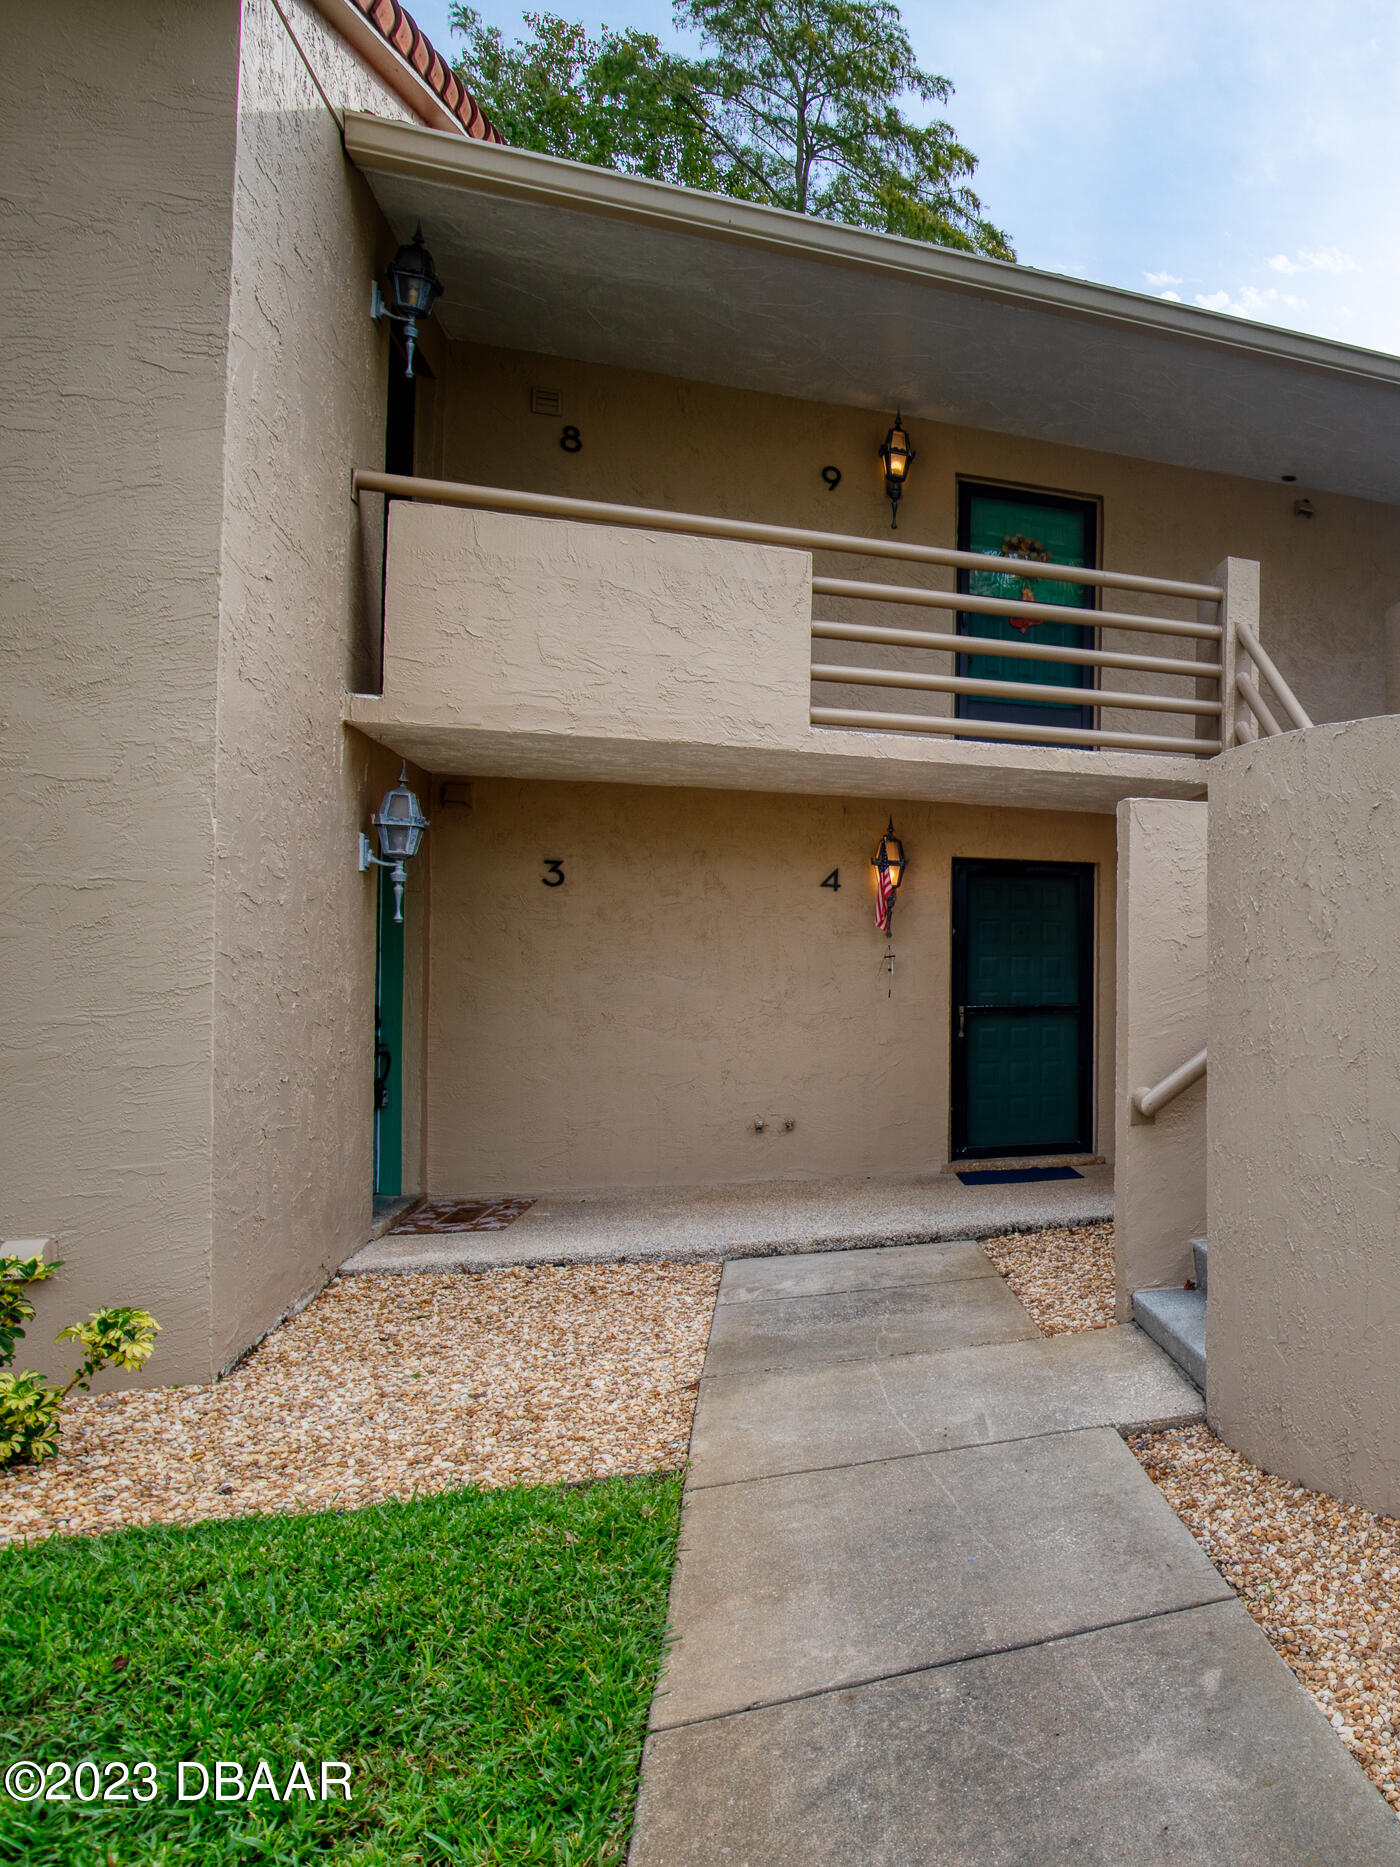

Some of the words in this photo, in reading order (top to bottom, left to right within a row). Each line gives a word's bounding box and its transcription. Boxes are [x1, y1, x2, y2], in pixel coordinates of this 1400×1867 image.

[560, 425, 582, 452] 8
[821, 465, 842, 491] 9
[542, 859, 565, 887] 3
[820, 868, 841, 892] 4
